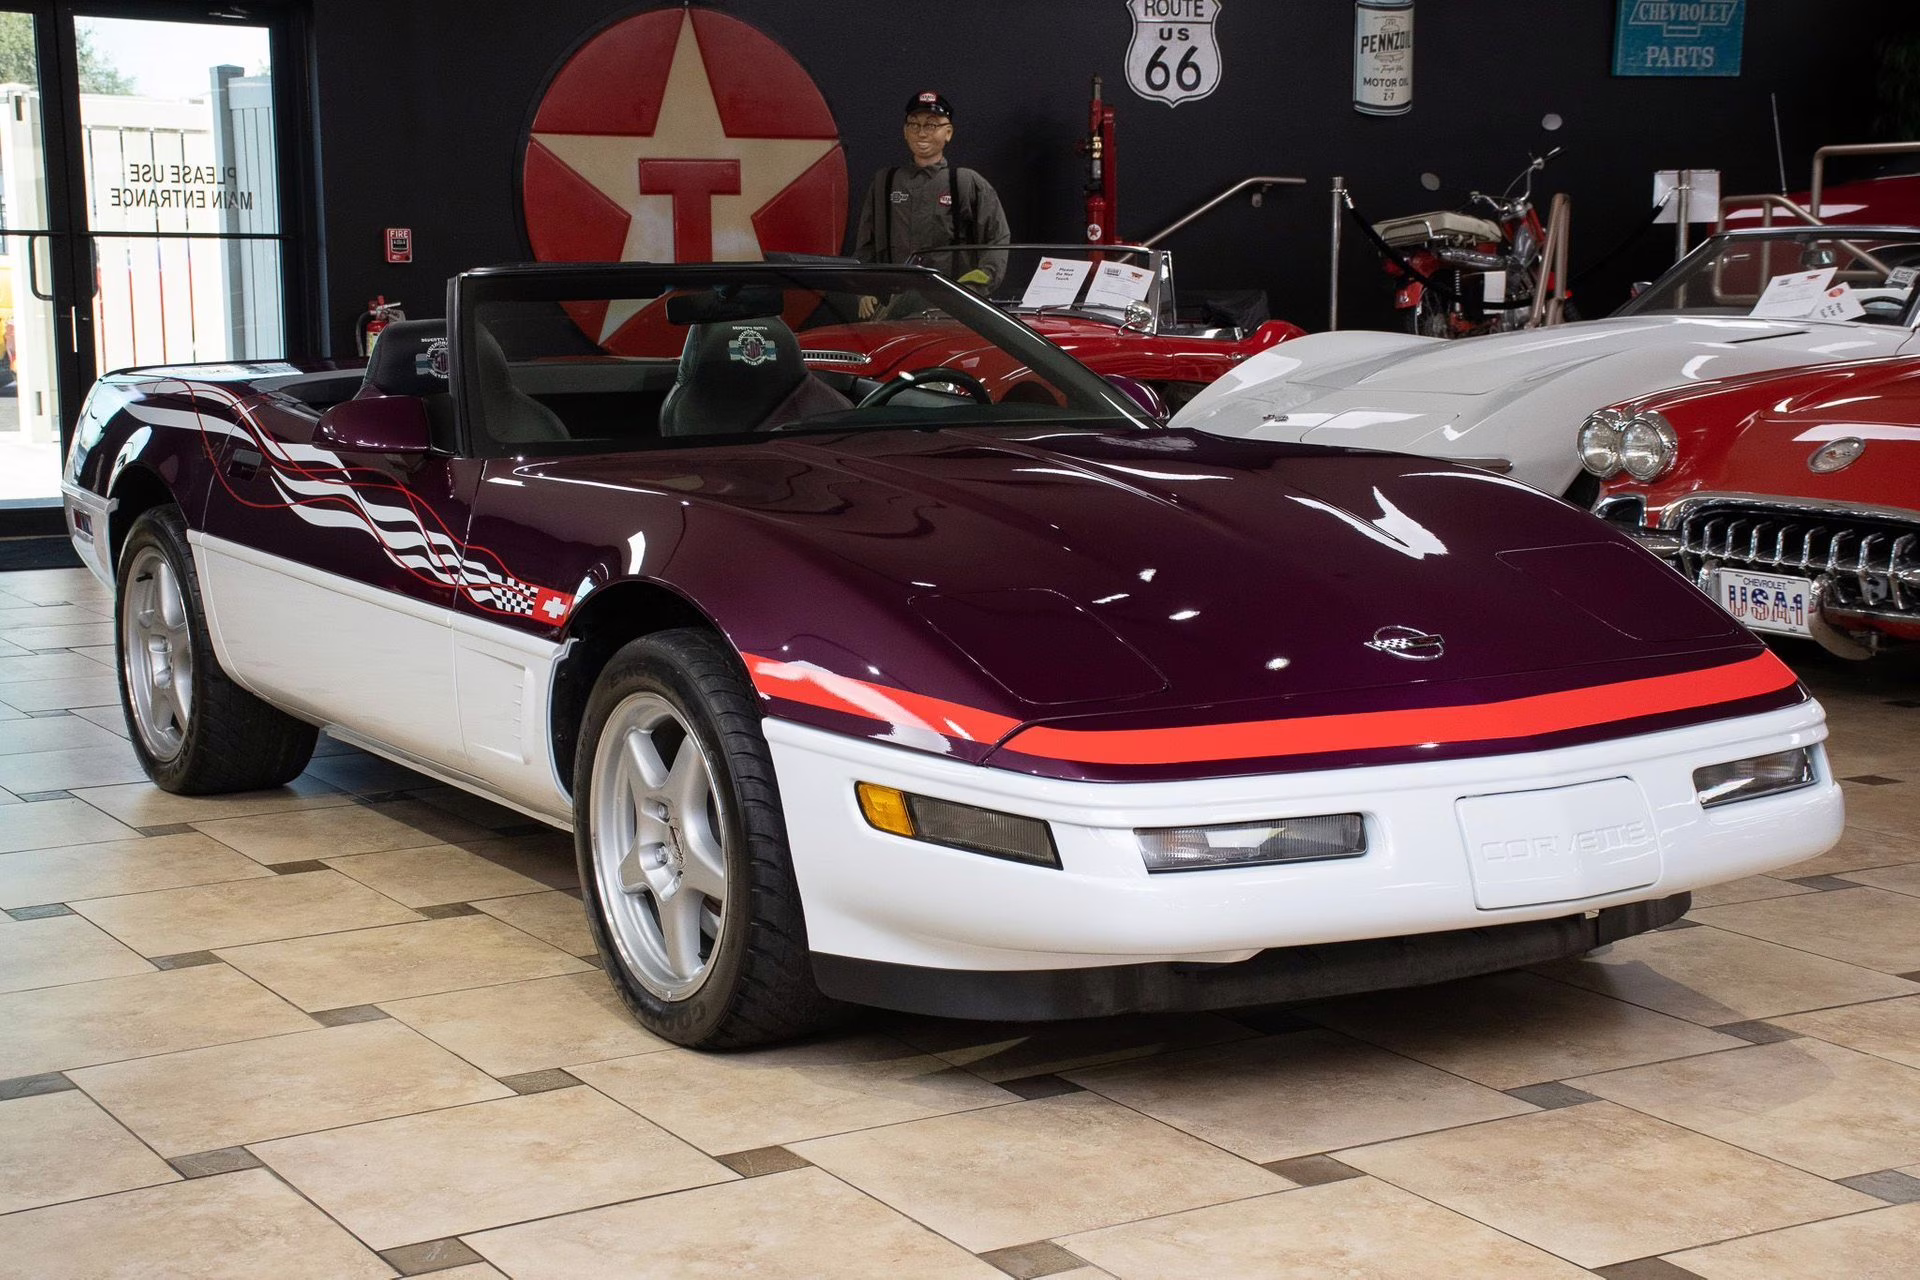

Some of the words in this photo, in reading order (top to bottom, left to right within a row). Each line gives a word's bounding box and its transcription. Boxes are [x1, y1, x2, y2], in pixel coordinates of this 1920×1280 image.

[1144, 0, 1204, 17] ROUTE
[1640, 2, 1730, 22] CHEVROLET
[1159, 27, 1190, 41] US
[1644, 46, 1715, 68] PARTS
[1145, 45, 1202, 92] 66
[1363, 77, 1398, 88] MOTOR
[390, 230, 409, 238] FIRE
